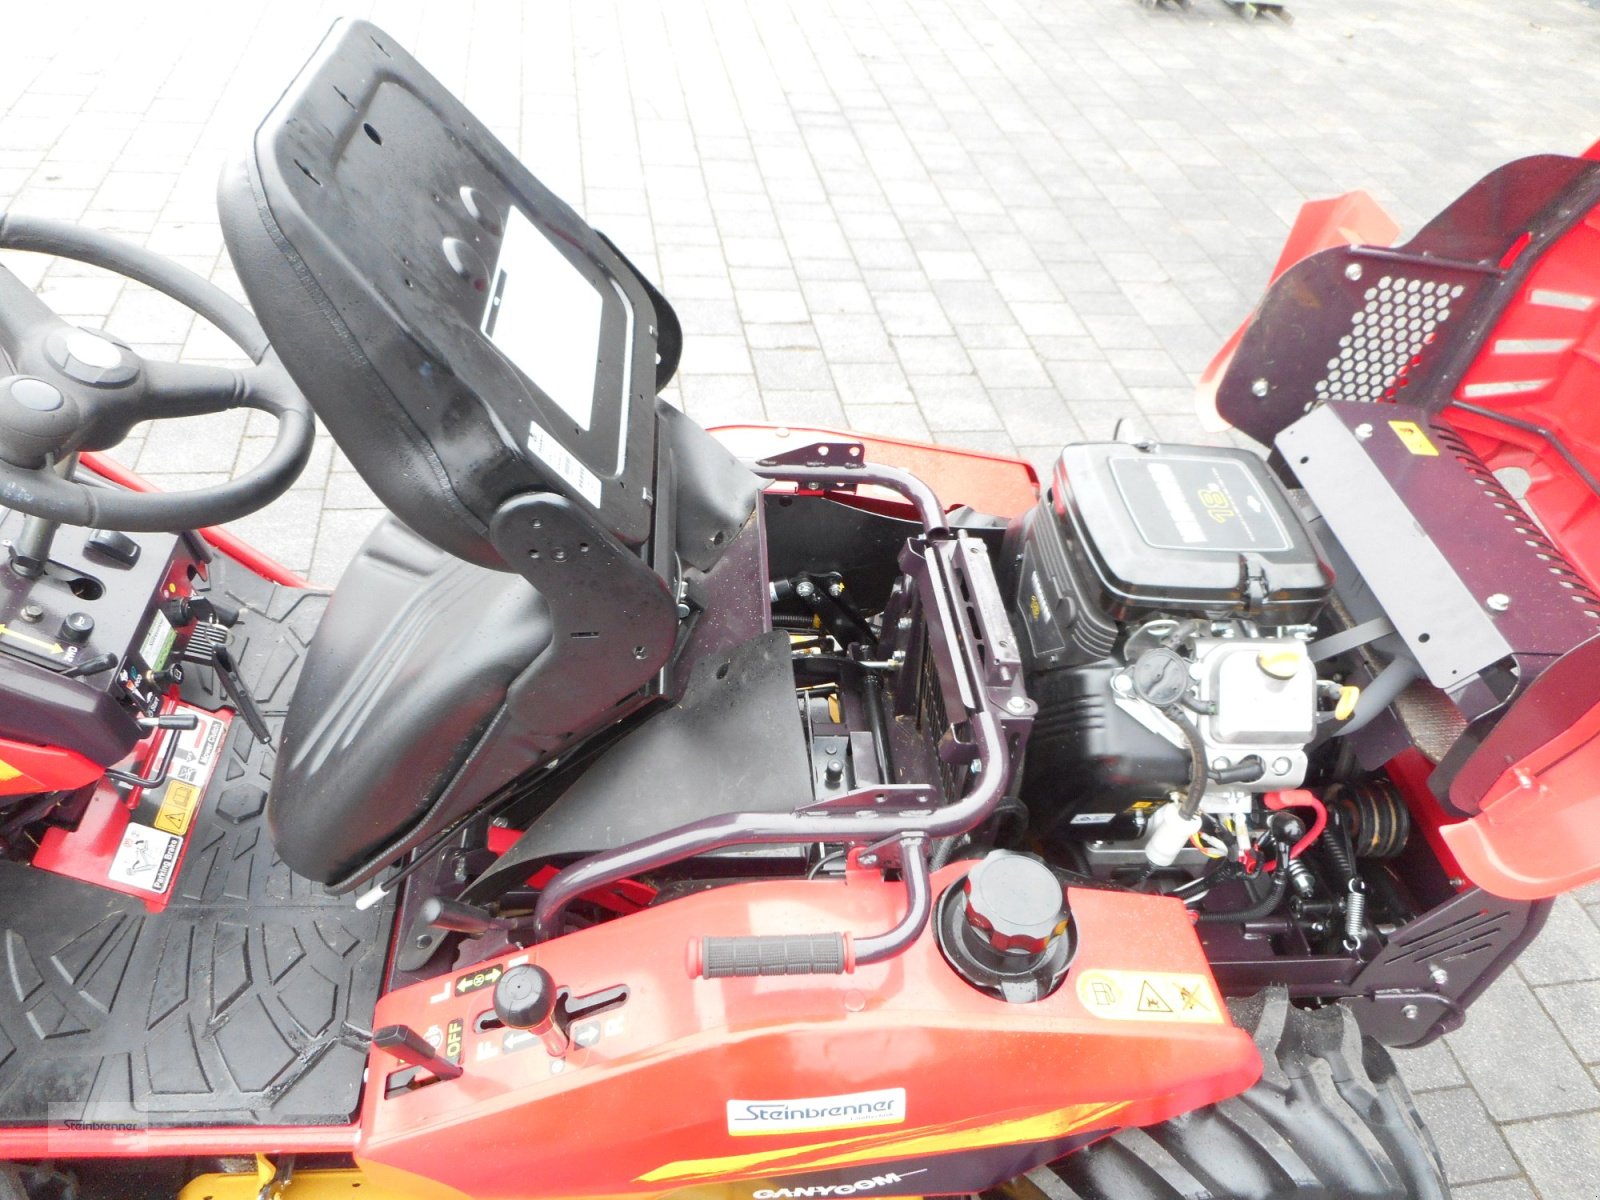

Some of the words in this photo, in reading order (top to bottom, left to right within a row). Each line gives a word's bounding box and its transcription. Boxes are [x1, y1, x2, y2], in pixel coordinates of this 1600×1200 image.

[154, 860, 171, 889] Parking
[164, 839, 179, 862] Brake
[447, 1022, 463, 1056] OFF
[735, 1100, 895, 1120] Steinbrenner
